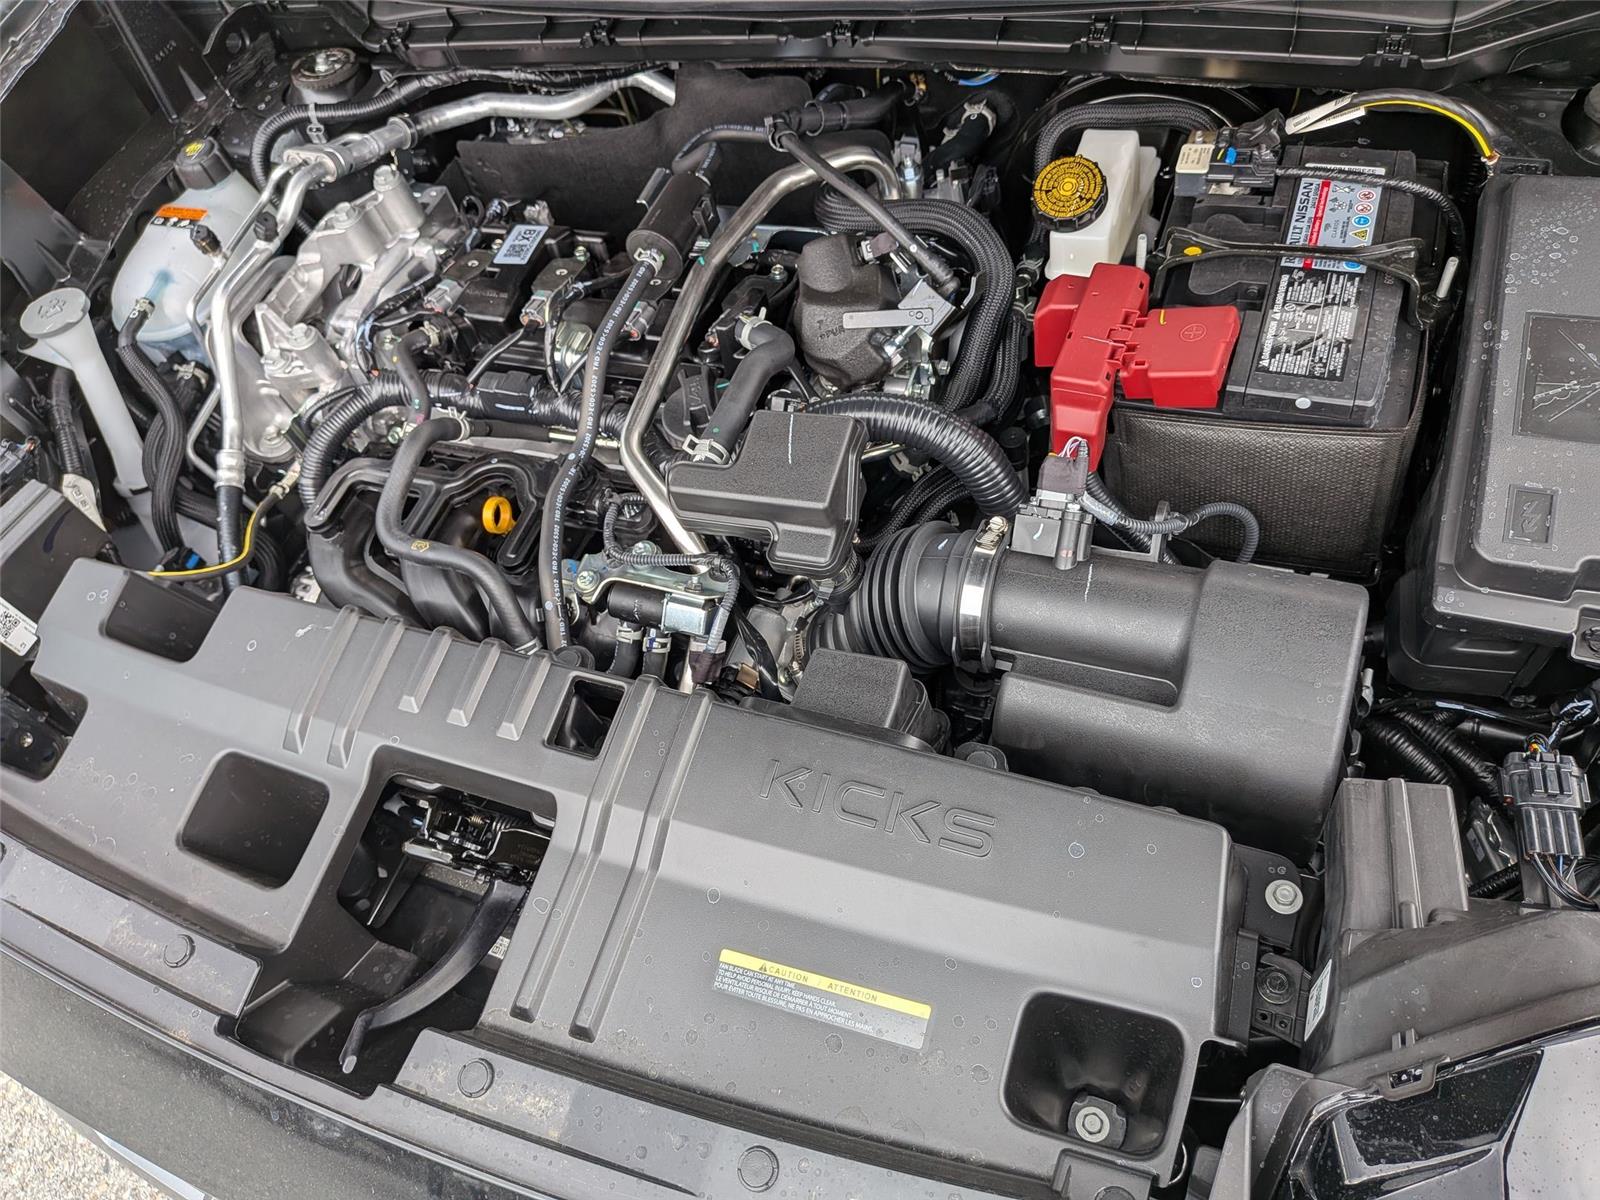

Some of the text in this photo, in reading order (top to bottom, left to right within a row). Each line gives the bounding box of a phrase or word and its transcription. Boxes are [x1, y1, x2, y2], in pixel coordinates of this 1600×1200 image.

[1294, 181, 1314, 223] NISSAN
[759, 758, 1000, 859] KICKS
[768, 966, 878, 1002] CAUTION ATTENTION
